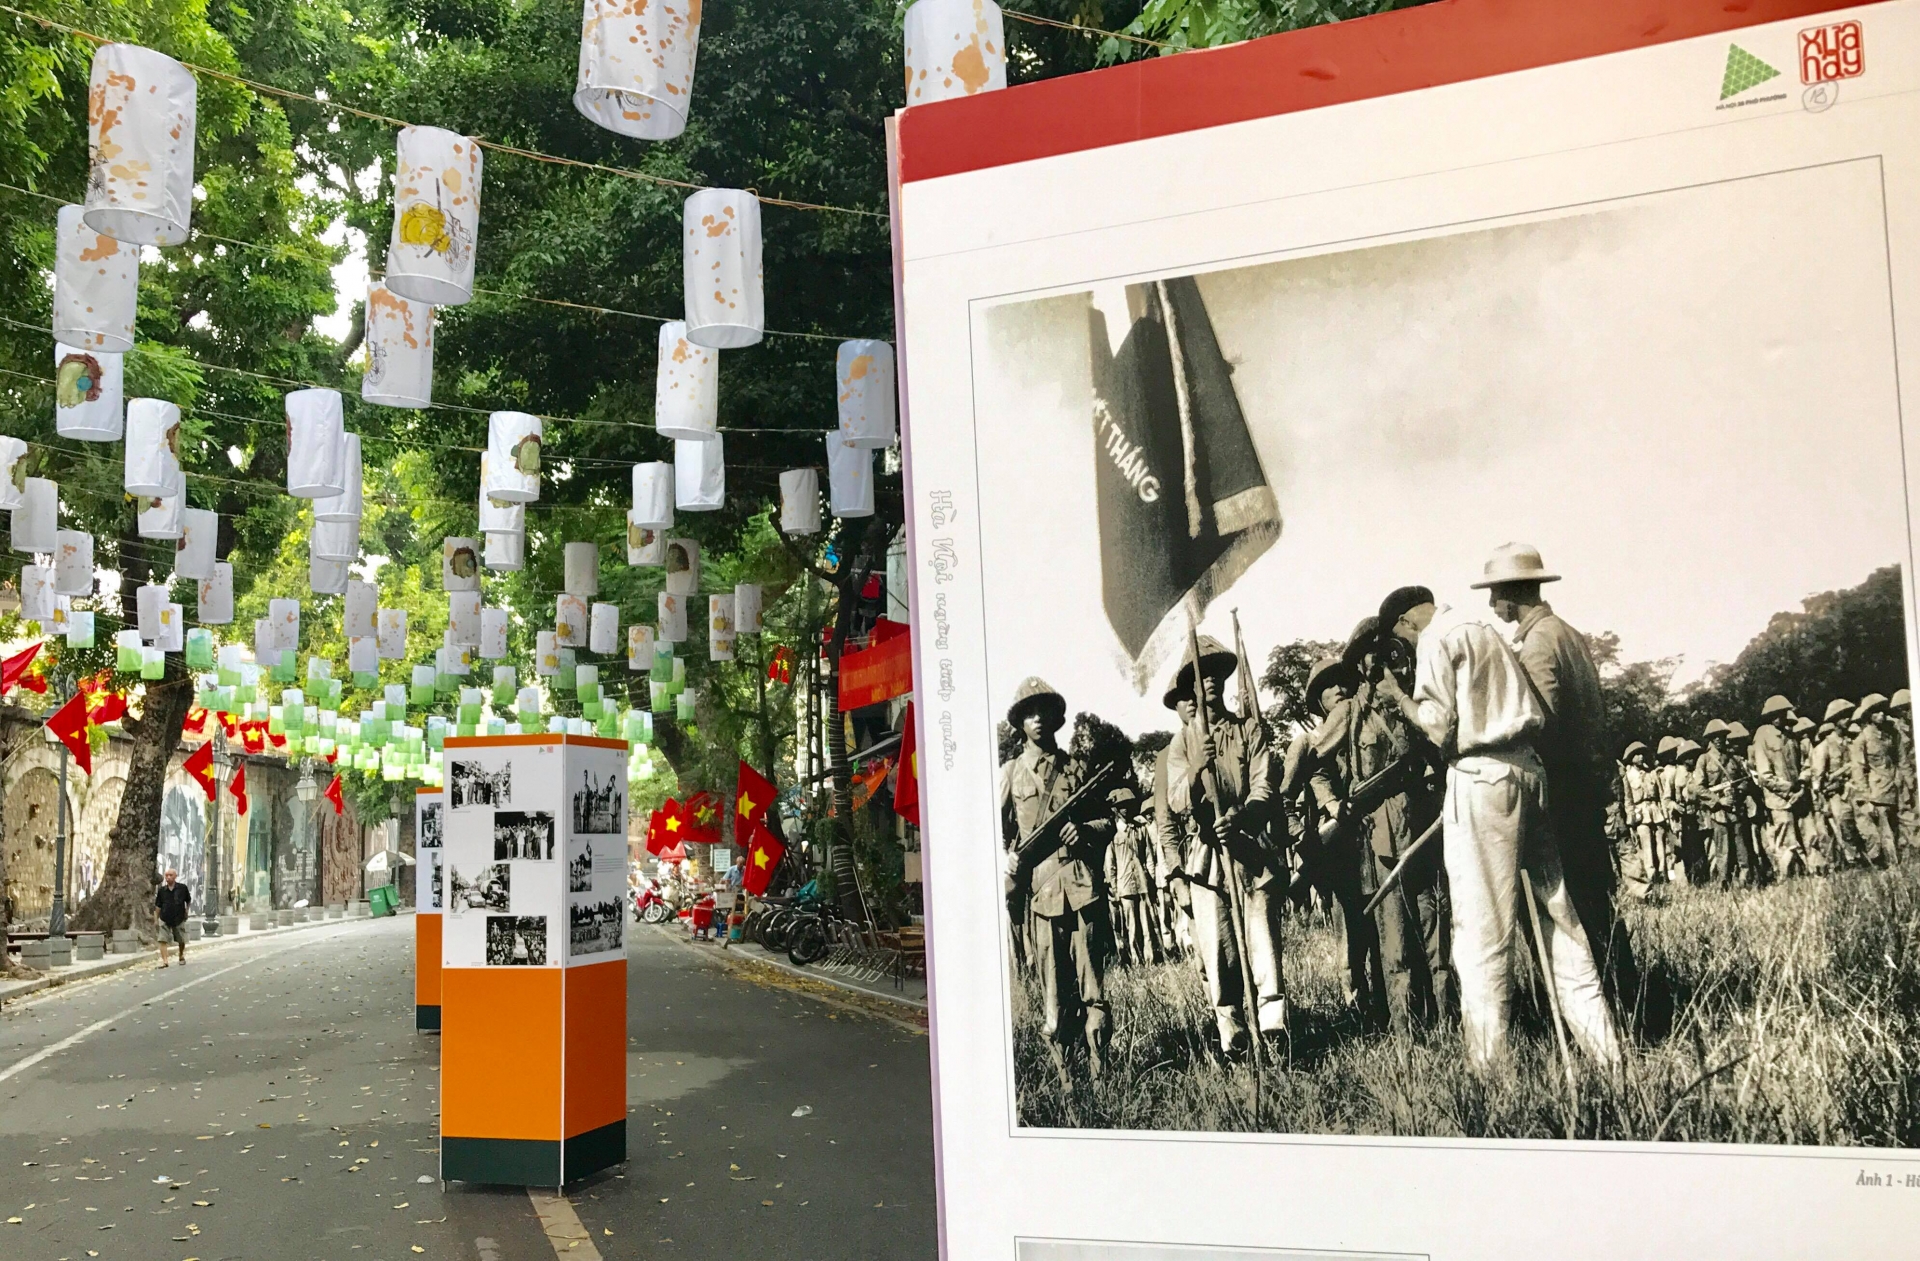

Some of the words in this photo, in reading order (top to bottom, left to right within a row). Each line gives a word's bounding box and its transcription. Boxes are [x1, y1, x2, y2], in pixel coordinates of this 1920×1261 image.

[929, 489, 957, 529] Hà
[928, 537, 958, 585] Nội
[934, 592, 950, 650] ngày
[1855, 1169, 1882, 1187] Ảnh
[1885, 1173, 1893, 1187] 1
